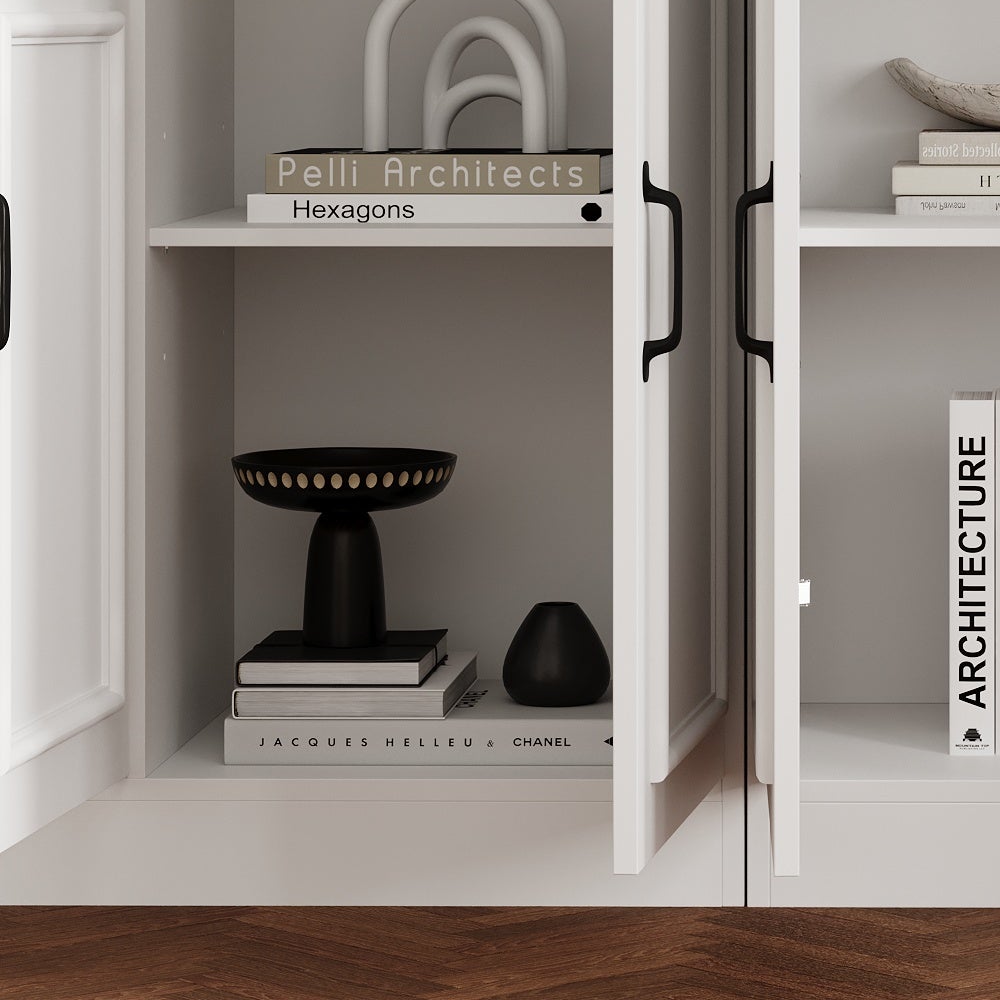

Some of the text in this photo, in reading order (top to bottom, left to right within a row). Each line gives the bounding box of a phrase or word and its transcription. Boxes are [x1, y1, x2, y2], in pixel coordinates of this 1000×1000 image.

[278, 157, 583, 187] Pelli Architects
[293, 200, 415, 222] Hexagons
[958, 436, 986, 709] ARCHITECTURE
[259, 737, 571, 748] JACQUES HELLEU & CHANEL
